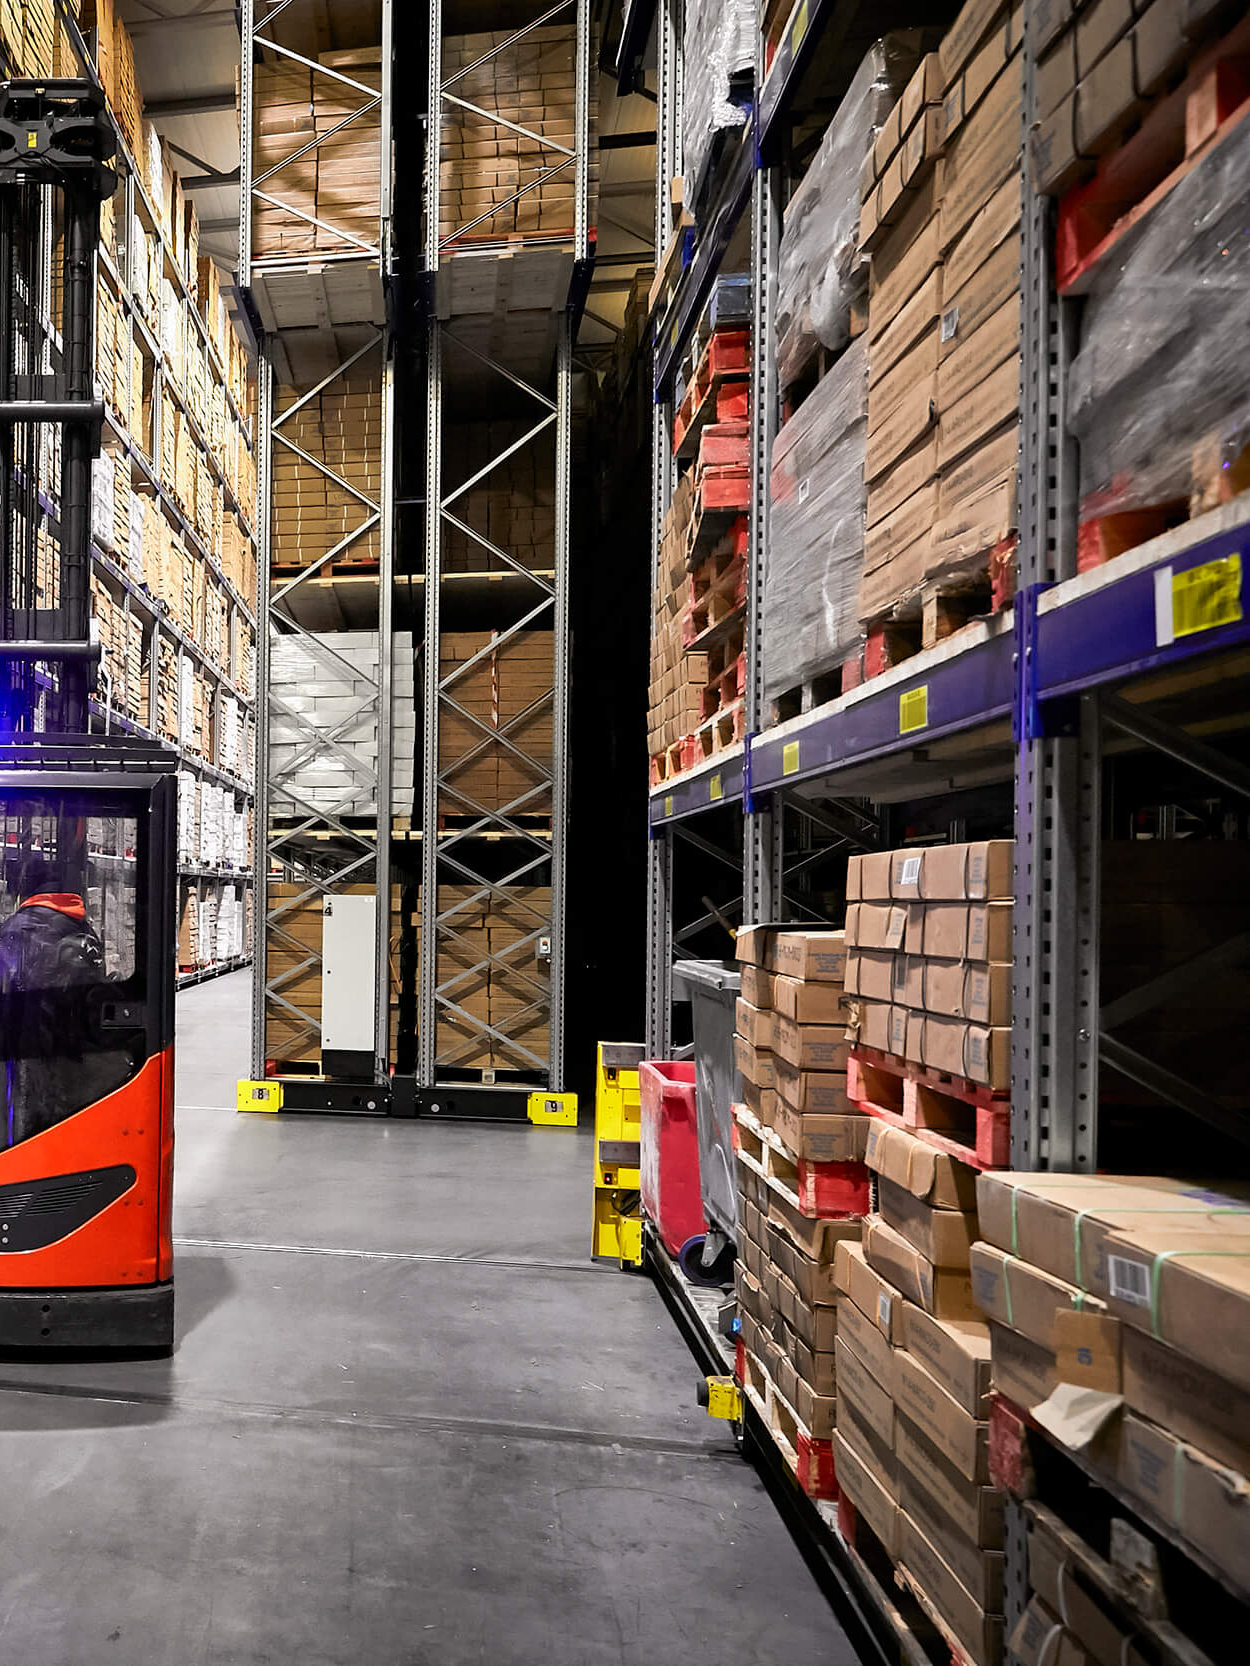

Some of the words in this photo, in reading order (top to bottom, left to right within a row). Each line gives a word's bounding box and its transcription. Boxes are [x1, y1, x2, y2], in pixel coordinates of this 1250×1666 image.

[324, 906, 333, 917] 4
[257, 1088, 264, 1100] 8
[550, 1100, 557, 1113] 9
